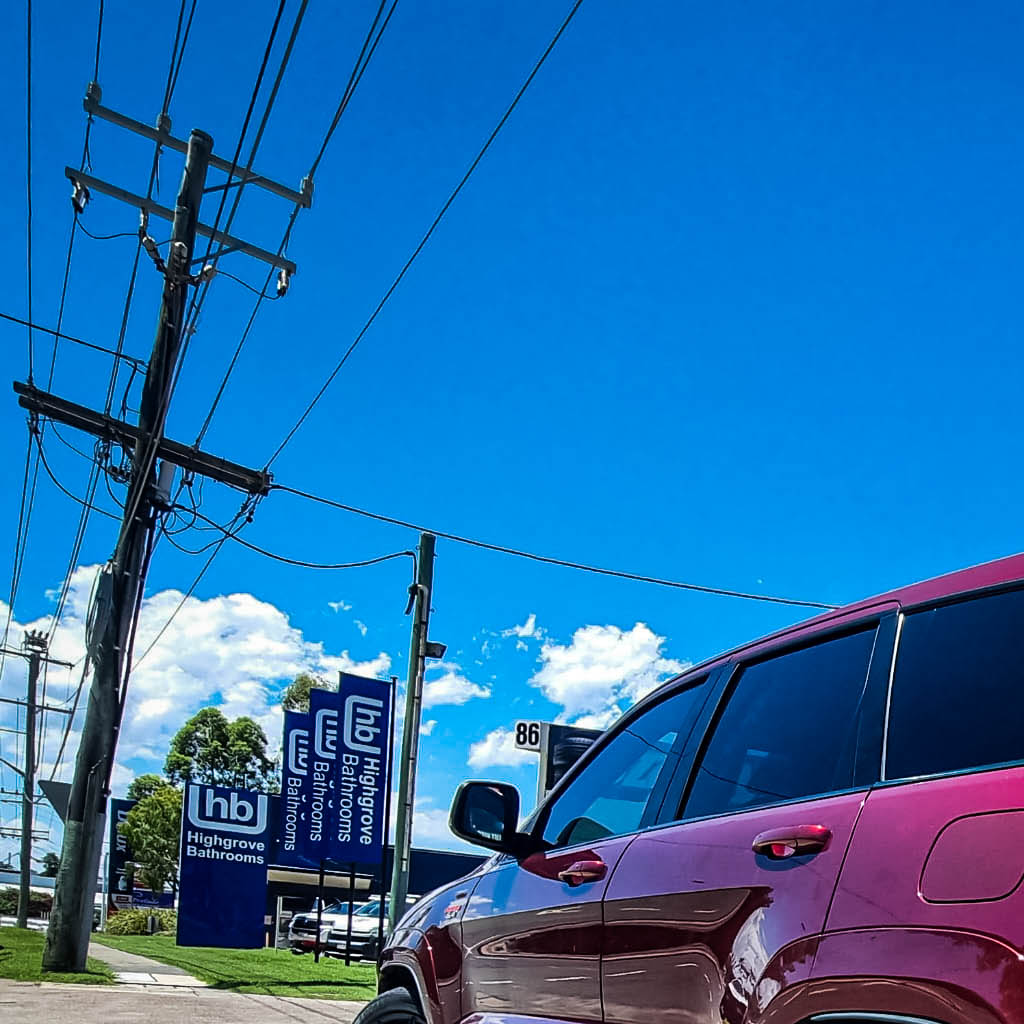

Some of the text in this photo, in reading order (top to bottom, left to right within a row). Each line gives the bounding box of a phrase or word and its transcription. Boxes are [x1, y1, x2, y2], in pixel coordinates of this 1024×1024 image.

[515, 722, 540, 746] 86
[284, 777, 302, 851] Bathrooms
[309, 761, 330, 842] Bathrooms
[338, 753, 360, 842] Bathrooms
[358, 757, 381, 845] Highgrove
[186, 845, 265, 864] Bathrooms
[187, 830, 265, 852] Highgrove
